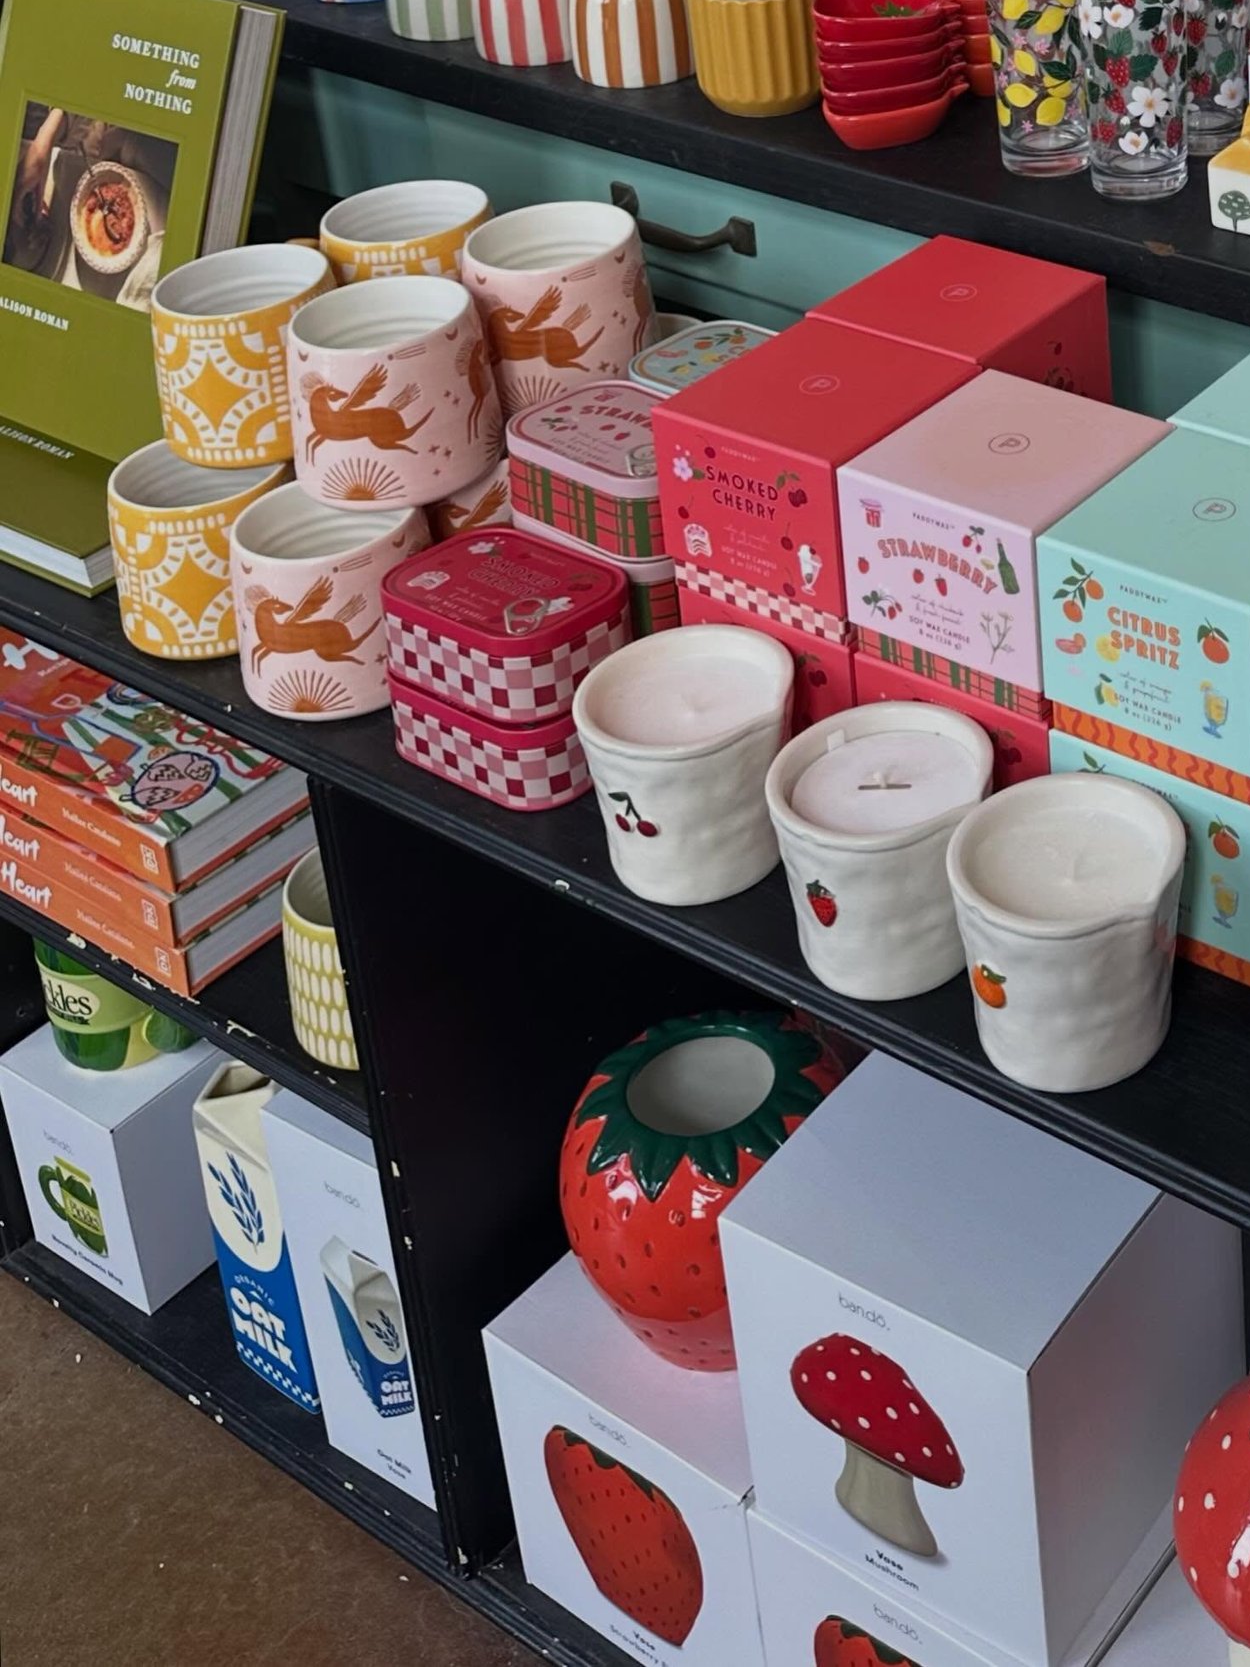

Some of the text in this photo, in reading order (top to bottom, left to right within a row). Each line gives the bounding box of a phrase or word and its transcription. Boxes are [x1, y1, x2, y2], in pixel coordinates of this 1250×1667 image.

[111, 33, 200, 69] SOMETHING
[165, 69, 197, 90] from
[123, 82, 192, 115] NOTHING
[0, 295, 70, 332] ALISON ROMAN
[34, 437, 75, 461] ROMAN
[706, 465, 778, 501] SMOKED
[712, 488, 777, 522] CHERRY
[877, 537, 998, 595] STRAWBERRY
[909, 615, 971, 644] SOY WAX CANDLE
[1107, 605, 1181, 647] CITRUS
[1110, 630, 1180, 670] SPRITZ
[1114, 692, 1182, 724] SOY WAX CANDLE
[142, 845, 159, 875] DK
[1, 861, 172, 977] Heart DK
[142, 899, 158, 930] DK
[45, 979, 92, 1016] ckles
[106, 1268, 124, 1286] Mug
[233, 1274, 275, 1308] ORGANIC
[230, 1287, 287, 1336] OAT
[231, 1310, 299, 1375] MILK
[380, 1380, 409, 1394] OAT
[380, 1393, 412, 1406] MILK
[864, 1553, 920, 1592] Mushroom
[876, 1549, 904, 1571] Vase
[632, 1629, 657, 1652] Vase
